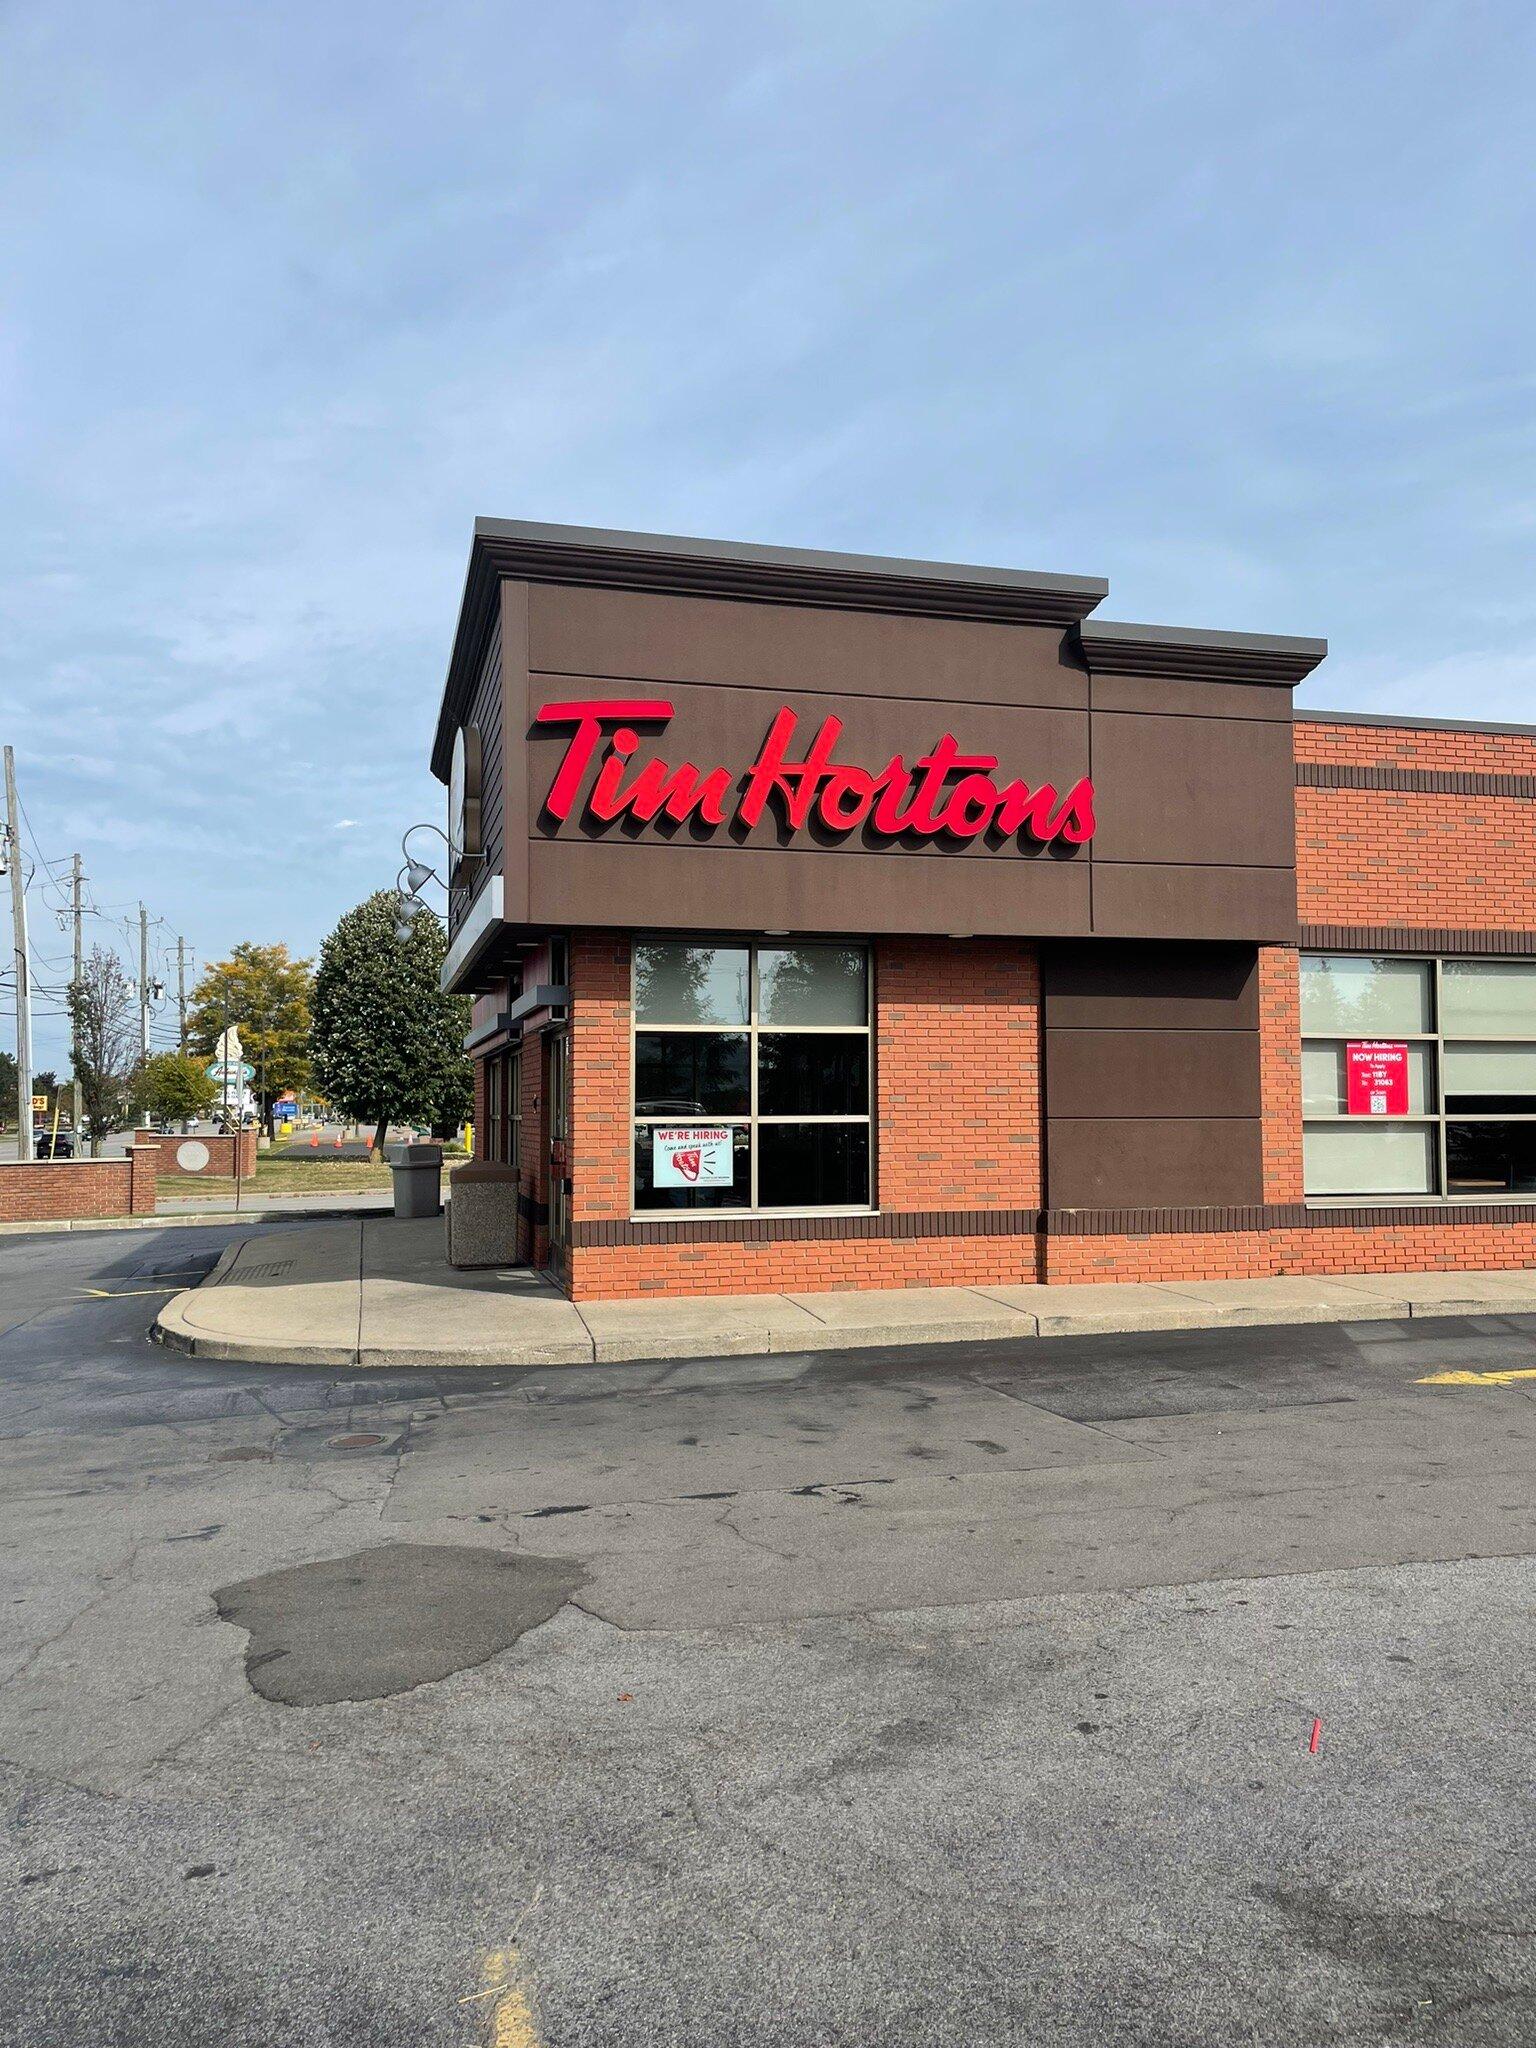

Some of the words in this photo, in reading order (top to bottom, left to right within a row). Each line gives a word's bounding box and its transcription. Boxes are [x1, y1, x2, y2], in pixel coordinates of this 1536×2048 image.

[537, 700, 732, 825] Tim
[739, 705, 1097, 845] Hortons
[1352, 1053, 1373, 1062] NOW
[1373, 1053, 1402, 1062] HIRING
[658, 1131, 690, 1140] WE'RE
[693, 1131, 729, 1140] HIRING
